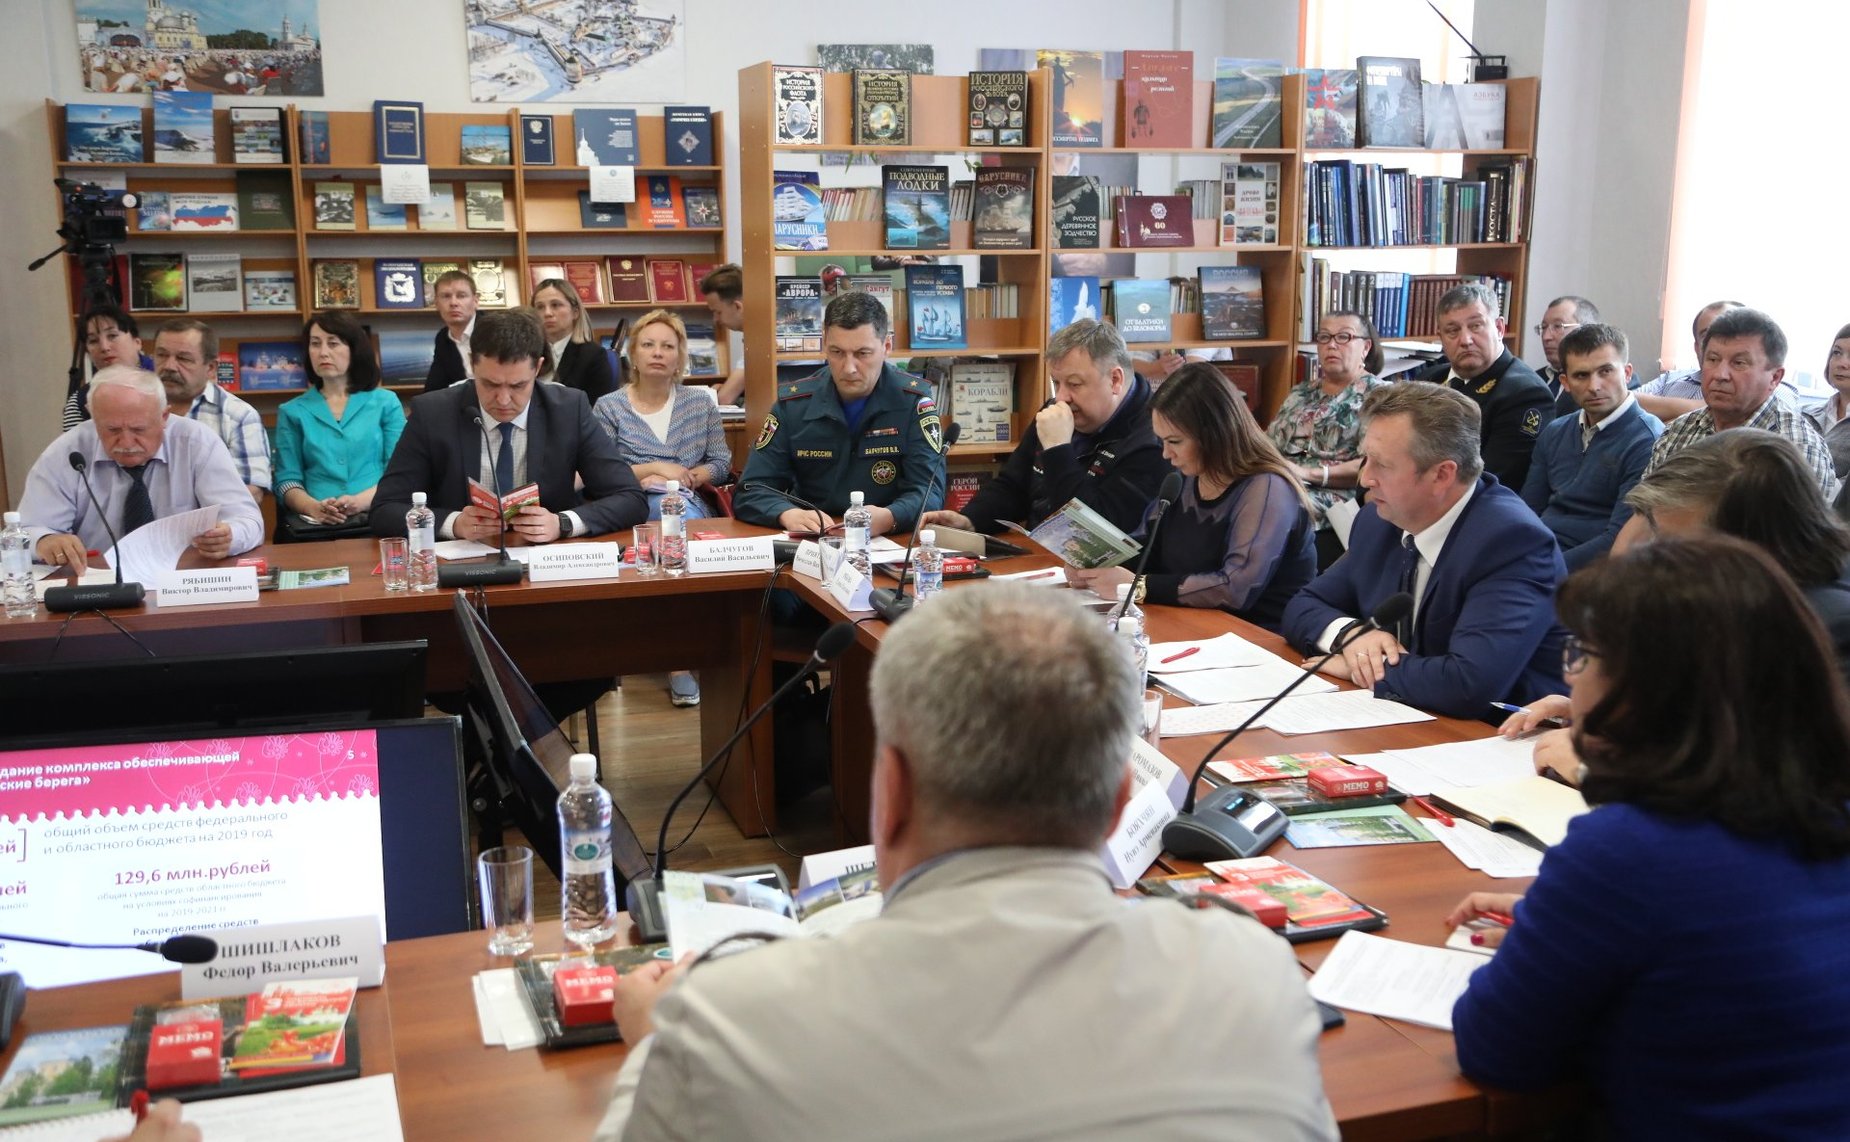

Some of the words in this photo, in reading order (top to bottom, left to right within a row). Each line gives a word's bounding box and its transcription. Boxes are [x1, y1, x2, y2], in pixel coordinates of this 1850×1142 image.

[971, 73, 1024, 86] ИСТОРИЯ
[889, 172, 945, 182] ПОДВОДНЫЕ
[978, 172, 1027, 182] ПАРУСНИКИ
[895, 181, 940, 191] ЛОДКИ
[864, 284, 890, 293] Гангут
[968, 387, 1008, 396] КОРАБЛИ
[710, 544, 754, 554] БАЛЧУГОВ
[542, 552, 604, 562] ОСИПОВСКИЙ
[695, 554, 726, 564] Василий
[727, 552, 770, 562] Васильевич
[533, 562, 566, 571] Владимир
[567, 560, 616, 570] Александрович
[182, 575, 232, 586] РЯБИШИН
[162, 586, 192, 596] Виктор
[193, 583, 253, 595] Владимирович
[347, 750, 355, 760] 5
[46, 760, 121, 774] комплекса
[122, 751, 240, 769] обеспечивающей
[0, 779, 32, 791] ские
[34, 775, 91, 790] берега»
[44, 824, 91, 838] общий
[94, 823, 139, 834] объем
[142, 819, 192, 832] средств
[196, 812, 288, 828] федерального
[44, 846, 52, 855] и
[56, 840, 134, 854] областного
[136, 836, 196, 848] бюджета
[199, 834, 214, 842] на
[218, 830, 248, 841] 2019
[252, 829, 273, 839] год
[115, 869, 161, 886] 129,6
[167, 860, 271, 881] млн.рублей
[97, 890, 128, 901] общая
[130, 888, 159, 898] сумма
[160, 886, 194, 896] средств
[196, 882, 246, 892] областного
[246, 878, 286, 890] бюджета
[133, 922, 217, 937] Распределение
[218, 918, 260, 930] средств
[221, 934, 342, 958] ШИШЛАКОВ
[203, 966, 256, 980] Федор
[262, 955, 359, 975] Валерьевич
